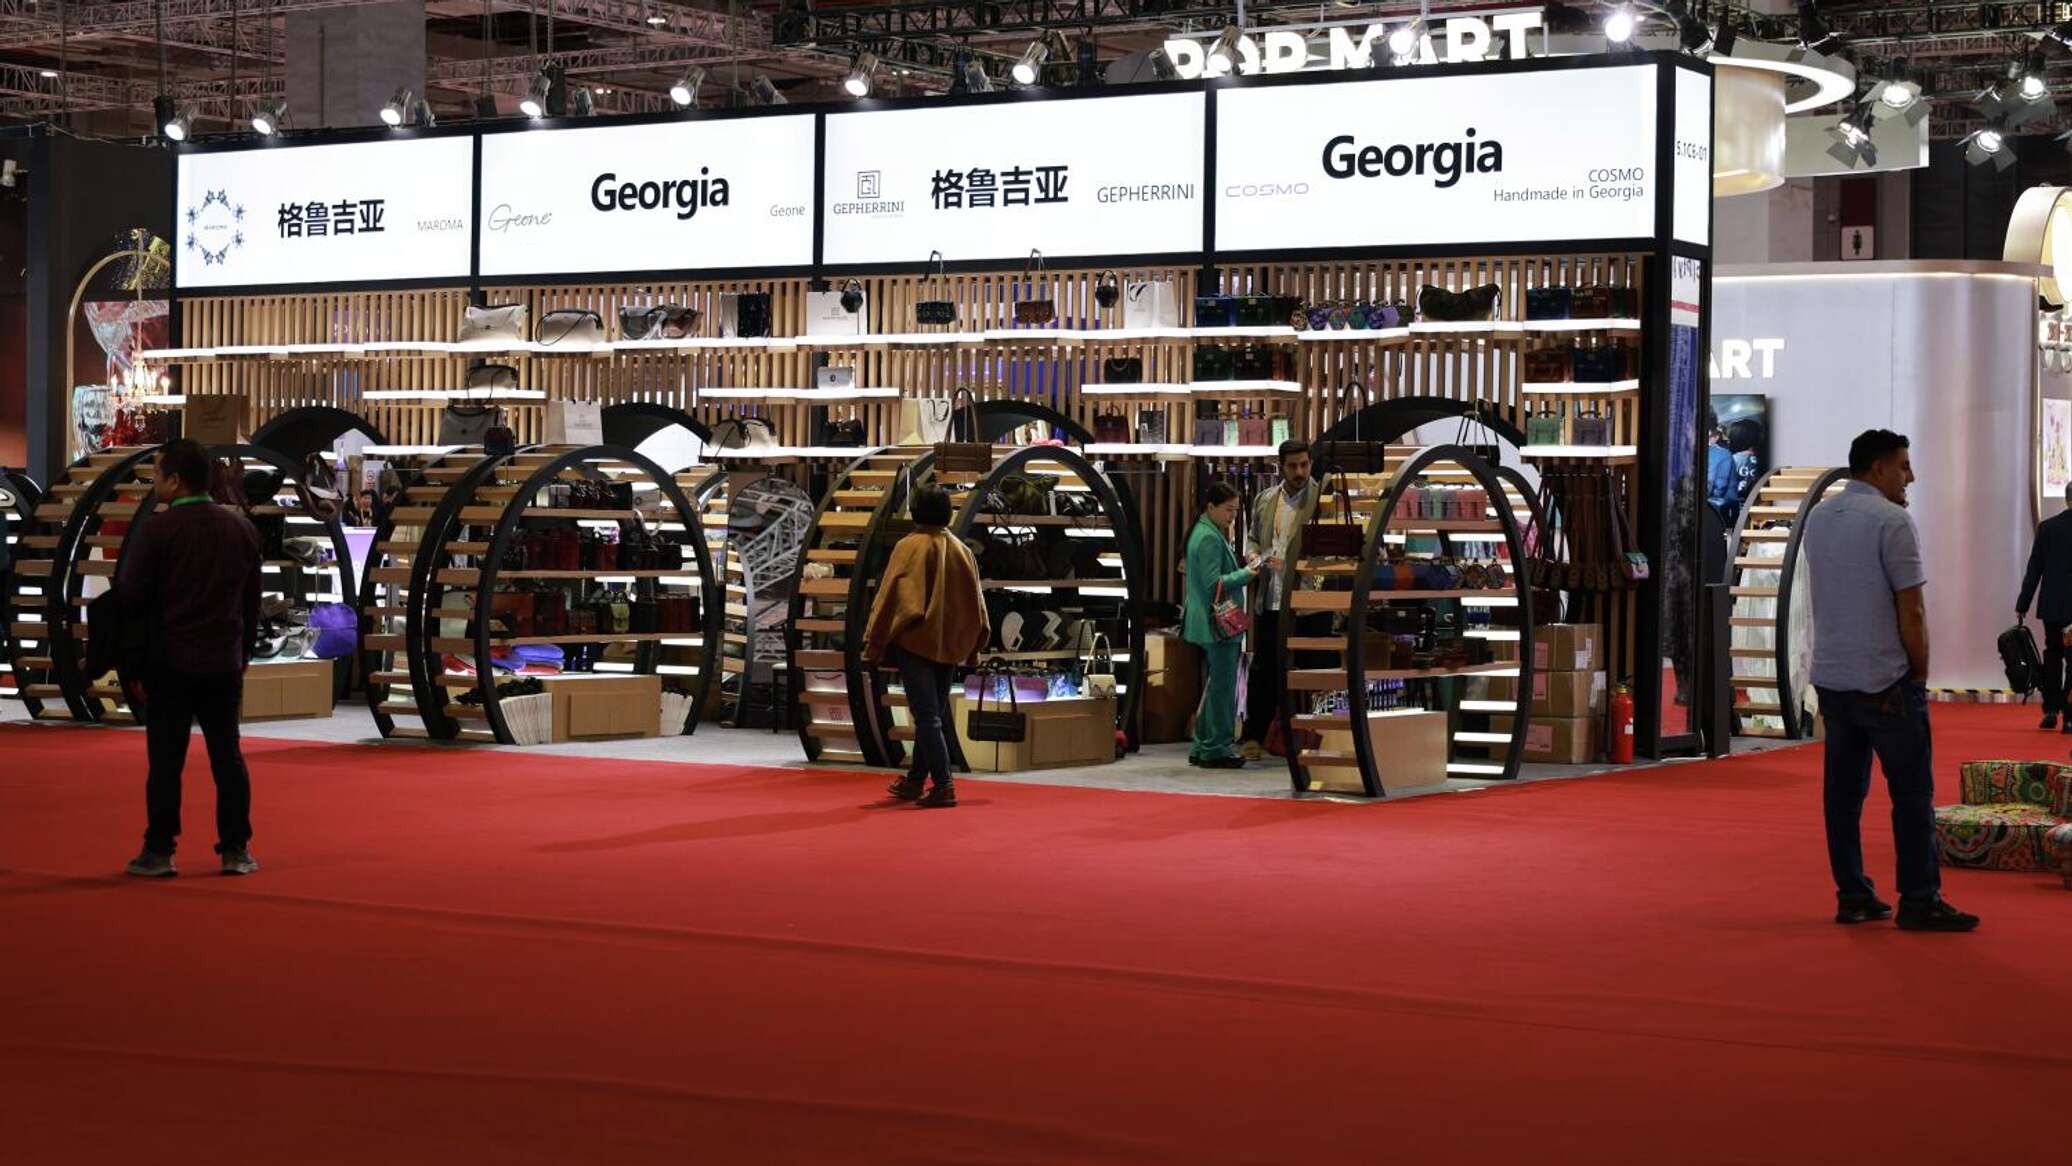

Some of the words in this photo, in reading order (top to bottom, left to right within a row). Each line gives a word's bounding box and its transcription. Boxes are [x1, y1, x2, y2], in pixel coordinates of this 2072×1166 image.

[1322, 127, 1503, 188] Georgia
[1588, 167, 1644, 183] COSMO
[590, 166, 729, 221] Georgia
[930, 165, 1069, 210] 格鲁吉亚
[1097, 183, 1194, 203] GEPHERRINI
[1226, 183, 1309, 198] COSMO
[1494, 187, 1567, 202] Handmade
[1573, 186, 1584, 200] in
[1589, 184, 1644, 202] Georgia
[770, 204, 805, 217] Geone
[833, 201, 904, 215] GEPHERRINI
[278, 199, 385, 239] 格鲁吉亚
[1710, 338, 1785, 379] RT
